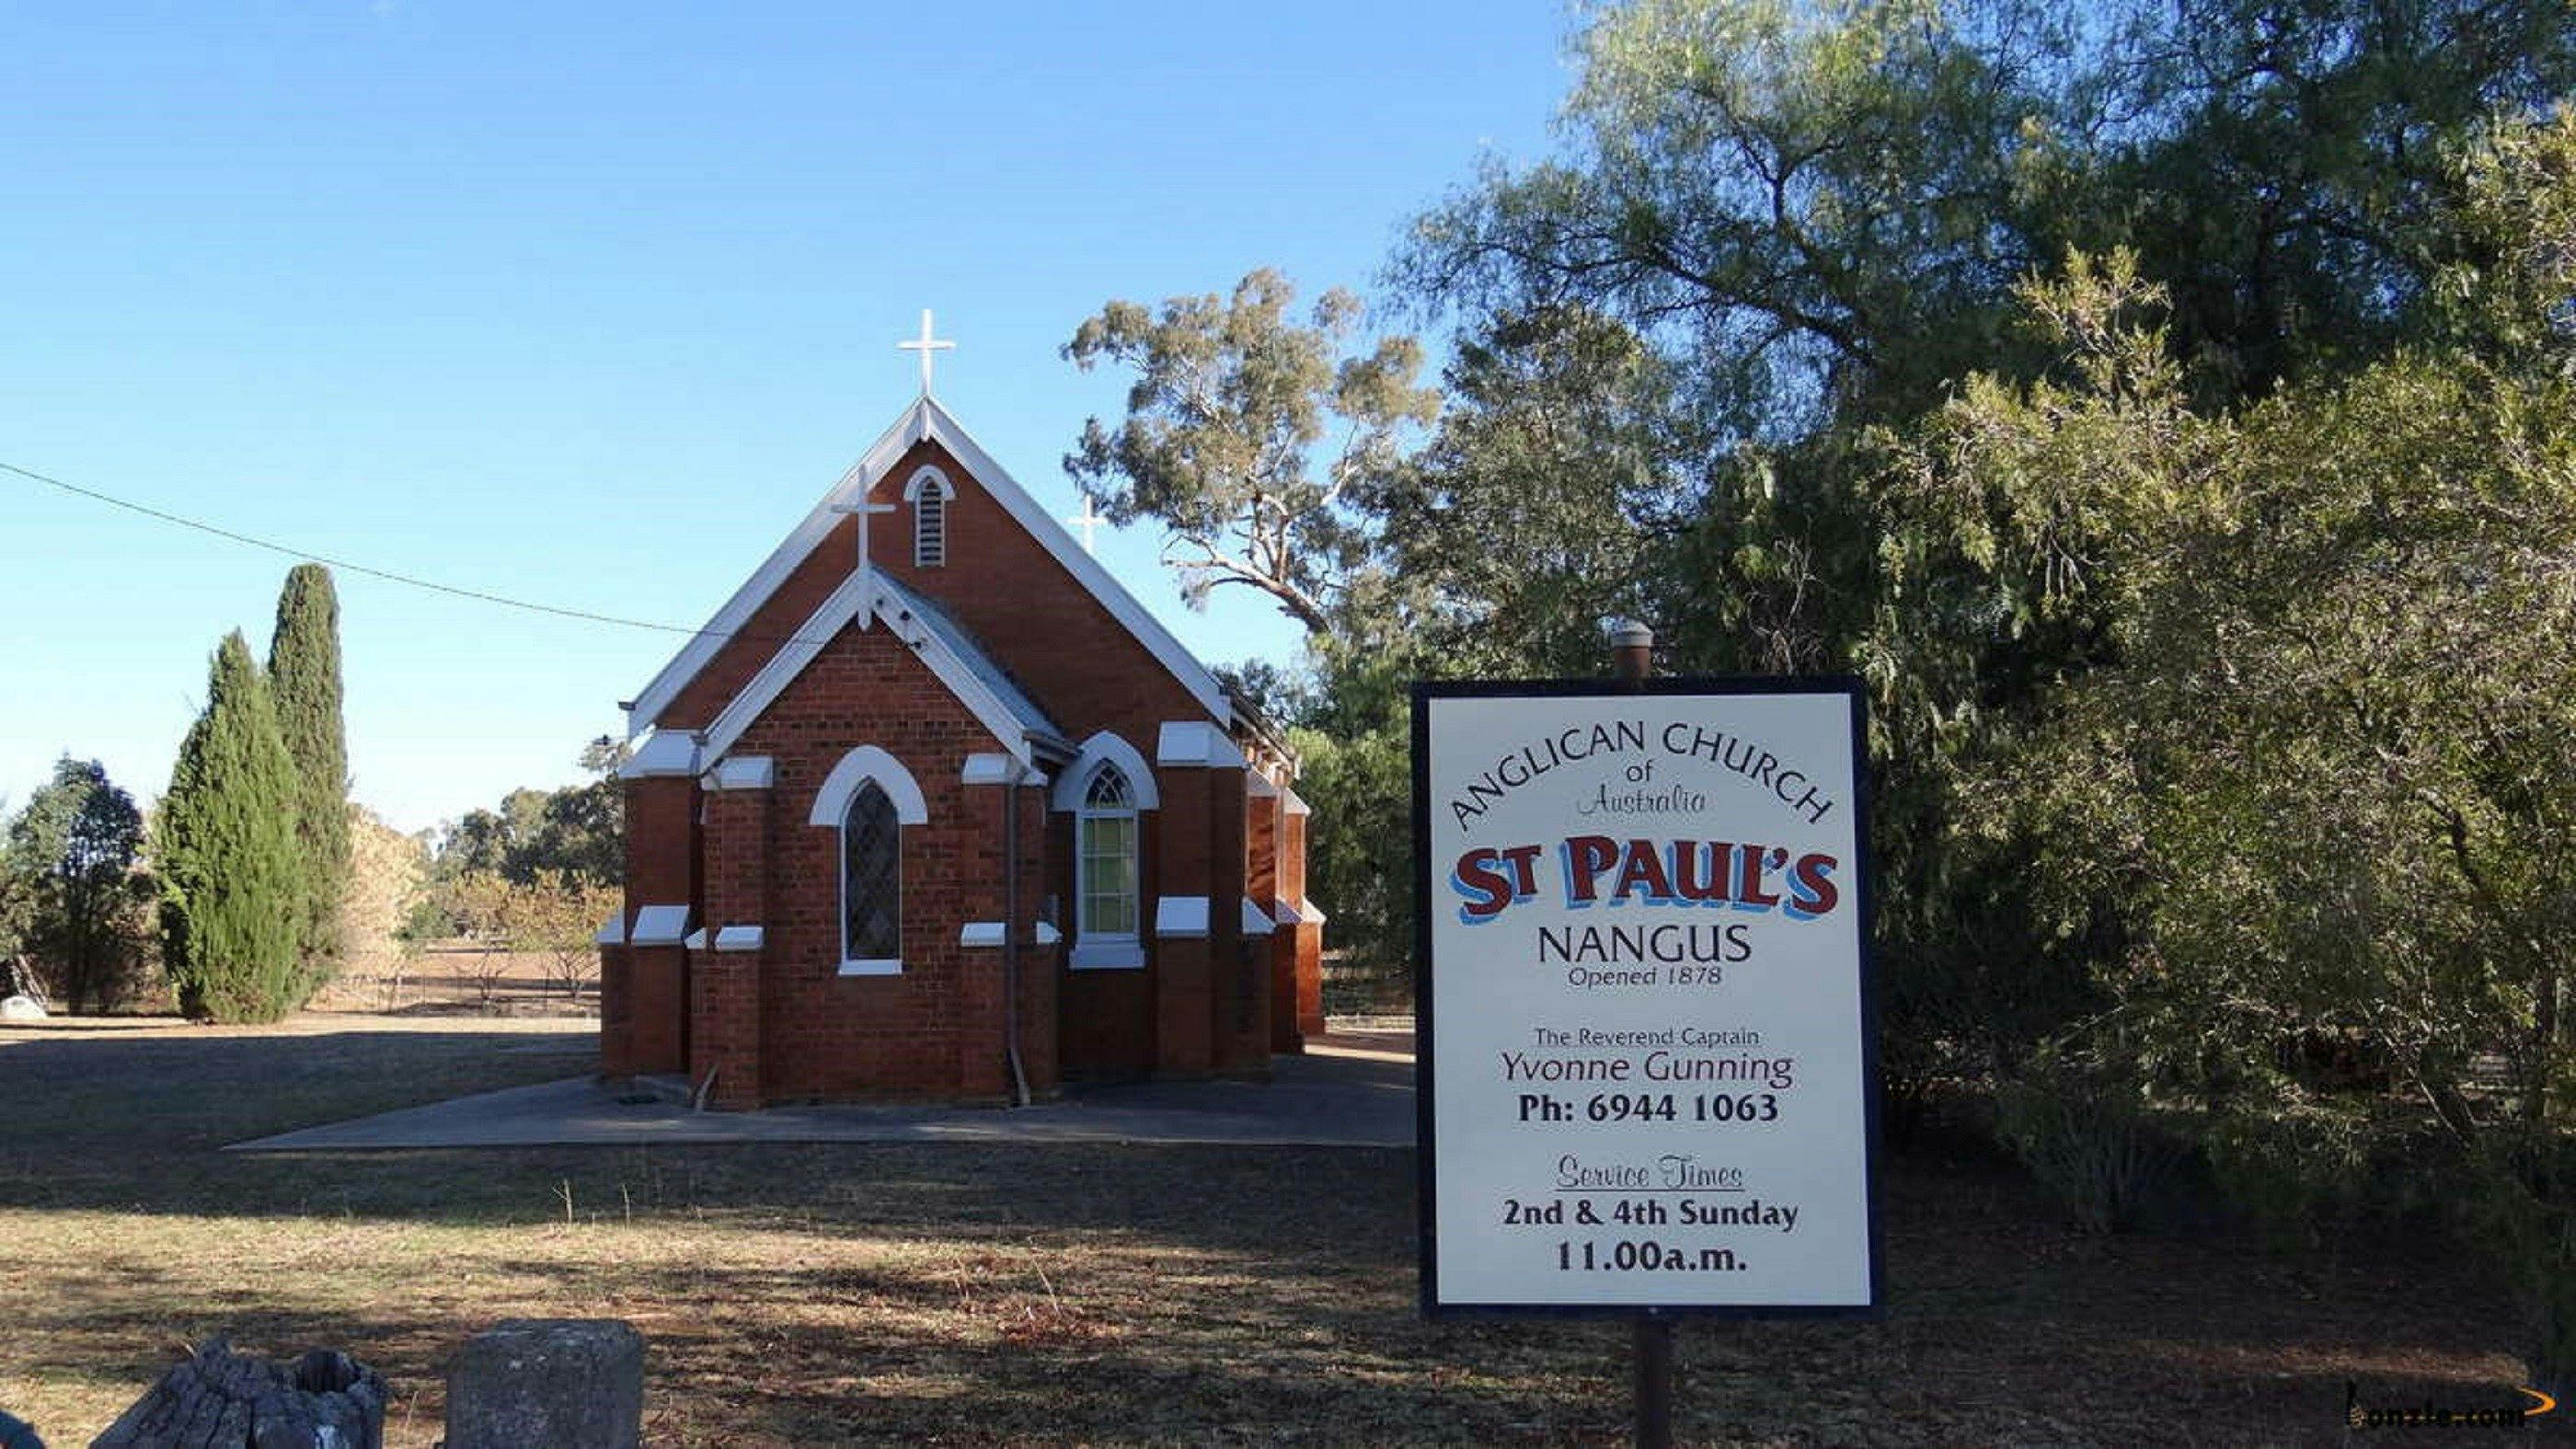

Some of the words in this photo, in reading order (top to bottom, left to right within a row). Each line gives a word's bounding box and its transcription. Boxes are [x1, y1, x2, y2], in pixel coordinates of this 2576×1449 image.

[1451, 720, 1646, 831] ANGLICAN
[1662, 722, 1834, 824] CHURCH
[1626, 758, 1655, 783] of
[1579, 784, 1706, 817] Australia
[1559, 834, 1838, 921] PAUL'S
[1538, 925, 1753, 964] NANGUS
[1568, 966, 1657, 990] Opened
[1667, 965, 1722, 986] 1878
[1535, 1028, 1572, 1047] The
[1579, 1027, 1674, 1047] Reverend
[1681, 1028, 1759, 1049] Captain
[1501, 1051, 1630, 1082] Yvonne
[1644, 1051, 1795, 1089] Gunning
[1519, 1093, 1574, 1122] Ph:
[1586, 1094, 1677, 1122] 6944
[1695, 1093, 1777, 1122] 1063
[1557, 1155, 1650, 1188] Service
[1658, 1155, 1742, 1189] Times
[1503, 1199, 1564, 1226] 2nd
[1575, 1200, 1605, 1225] &
[1612, 1199, 1667, 1225] 4th
[1679, 1199, 1799, 1233] Sunday
[1558, 1240, 1747, 1271] 11.00a.m.
